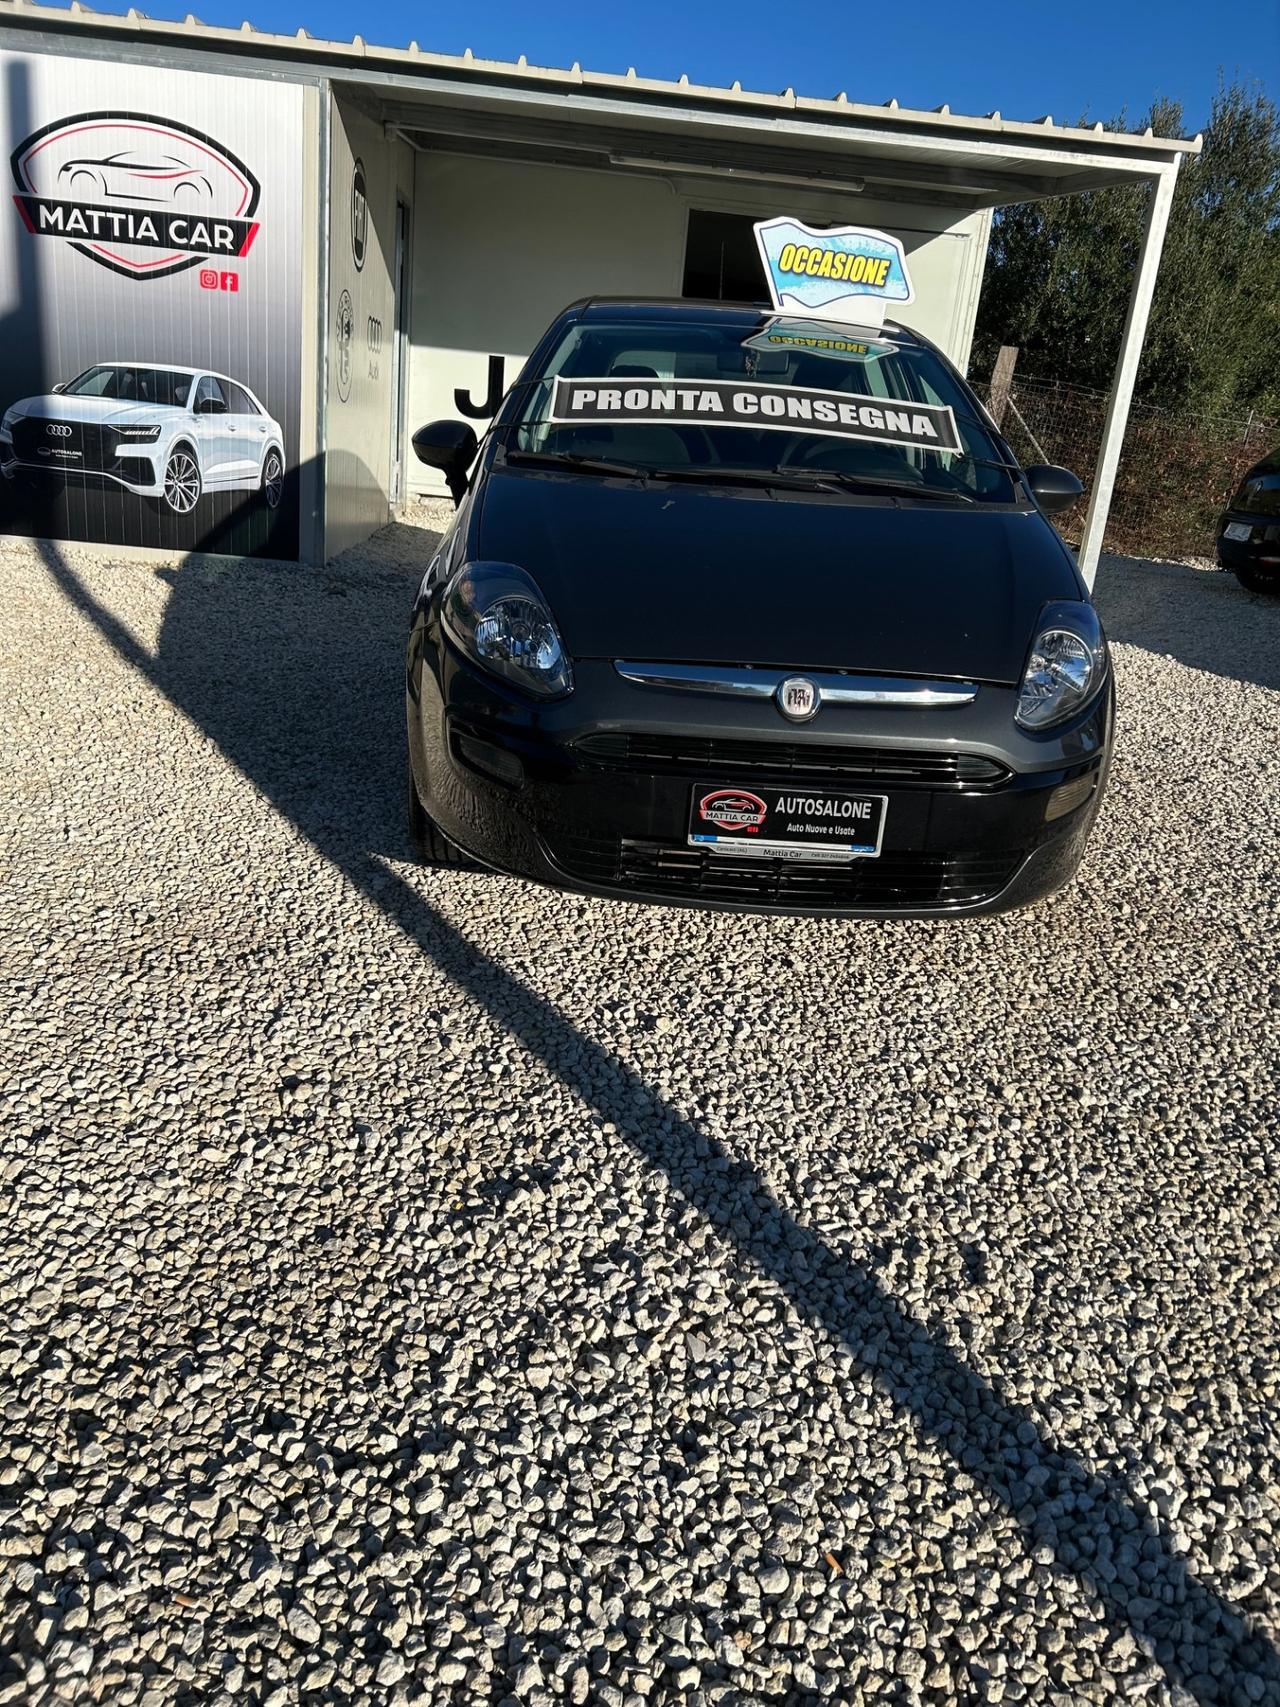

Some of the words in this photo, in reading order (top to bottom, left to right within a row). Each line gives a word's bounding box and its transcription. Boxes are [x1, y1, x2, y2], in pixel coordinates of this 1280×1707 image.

[39, 204, 160, 241] MATTIA
[168, 219, 235, 250] CAR
[779, 243, 891, 287] OCCASIONE
[571, 388, 725, 413] PRONTA
[733, 392, 939, 438] CONSEGNA
[705, 811, 739, 821] MATTIA
[740, 814, 759, 822] CAR
[775, 796, 872, 819] AUTOSALONE
[786, 822, 804, 833] Auto
[805, 824, 828, 834] Nuove
[834, 825, 856, 836] Usate
[763, 848, 789, 857] Mattia
[789, 850, 802, 858] Car
